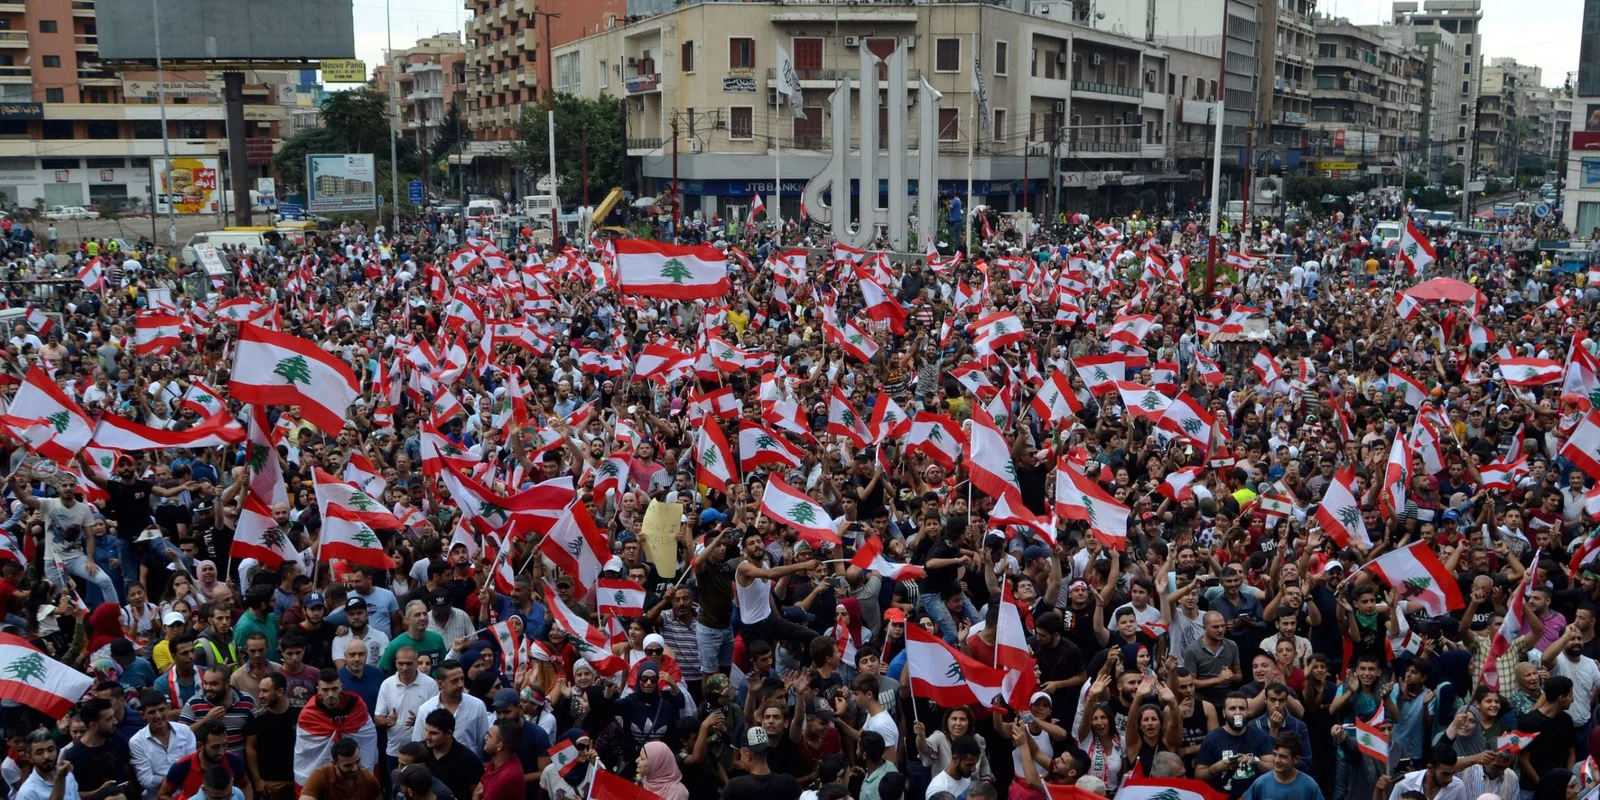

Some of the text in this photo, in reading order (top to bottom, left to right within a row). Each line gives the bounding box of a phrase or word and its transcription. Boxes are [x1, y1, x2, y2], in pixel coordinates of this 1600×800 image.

[322, 61, 363, 69] Nouvo Pano
[198, 168, 215, 178] عرض
[745, 182, 765, 192] JTB
[1472, 612, 1495, 622] BOS
